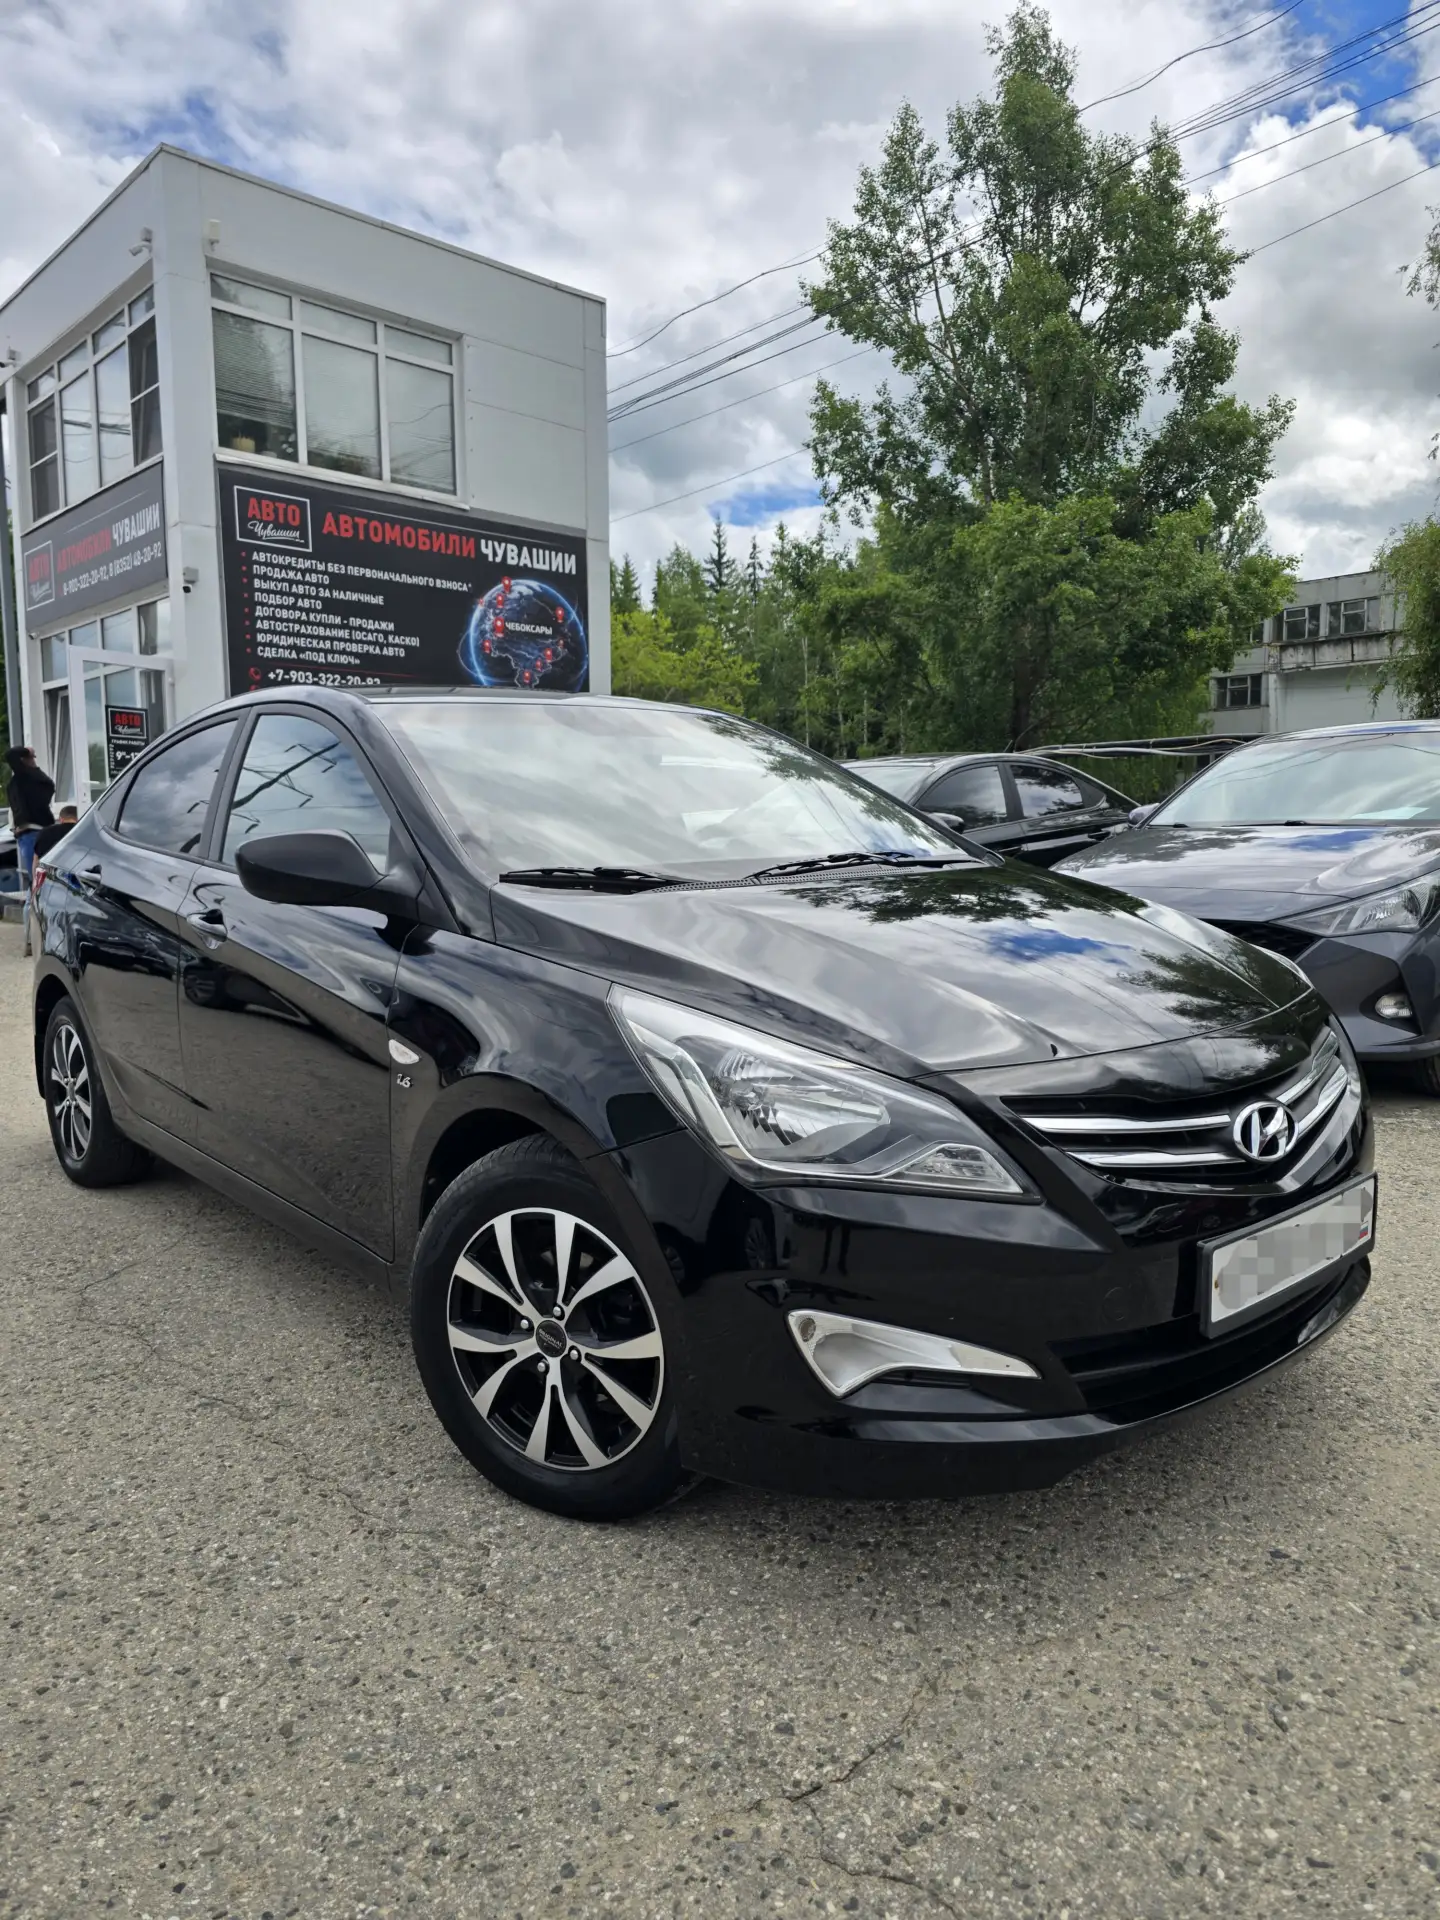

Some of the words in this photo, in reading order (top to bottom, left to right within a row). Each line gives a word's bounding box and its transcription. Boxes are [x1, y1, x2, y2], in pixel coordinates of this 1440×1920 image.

[112, 502, 160, 547] ЧУВАШИИ
[247, 497, 301, 527] АВТО
[322, 511, 476, 560] АВТОМОБИЛИ
[480, 538, 577, 576] ЧУВАШИИ
[252, 551, 326, 571] АВТОКРЕДИТЫ
[327, 562, 346, 574] БЕЗ
[347, 565, 435, 587] ПЕРВОНАЧАЛЬНОГО
[253, 564, 303, 581] ПРОДАЖА
[304, 572, 330, 585] АВТО
[254, 578, 290, 592] ВЫКУП
[291, 584, 317, 596] АВТО
[318, 588, 331, 598] ЗА
[332, 589, 384, 605] НАЛИЧНЫЕ
[254, 591, 295, 606] ПОДБОР
[297, 597, 322, 610] АВТО
[255, 605, 308, 621] ДОГОВОРА
[309, 612, 341, 625] КУПЛИ
[348, 617, 395, 632] ПРОДАЖИ
[505, 621, 553, 636] ЧЕБОКСАРЫ
[256, 619, 350, 640] АВТОСТРАХОВАНИЕ
[352, 630, 387, 644] (ОСАГО,
[388, 634, 420, 647] КАСКО)
[256, 632, 332, 650] ЮРИДИЧЕСКАЯ
[333, 641, 380, 655] ПРОВЕРКА
[382, 646, 405, 658] АВТО
[257, 646, 298, 660] СДЕЛКА
[299, 651, 326, 664] «ПОД
[327, 653, 360, 665] КЛЮЧ»
[115, 711, 142, 727] АВТО
